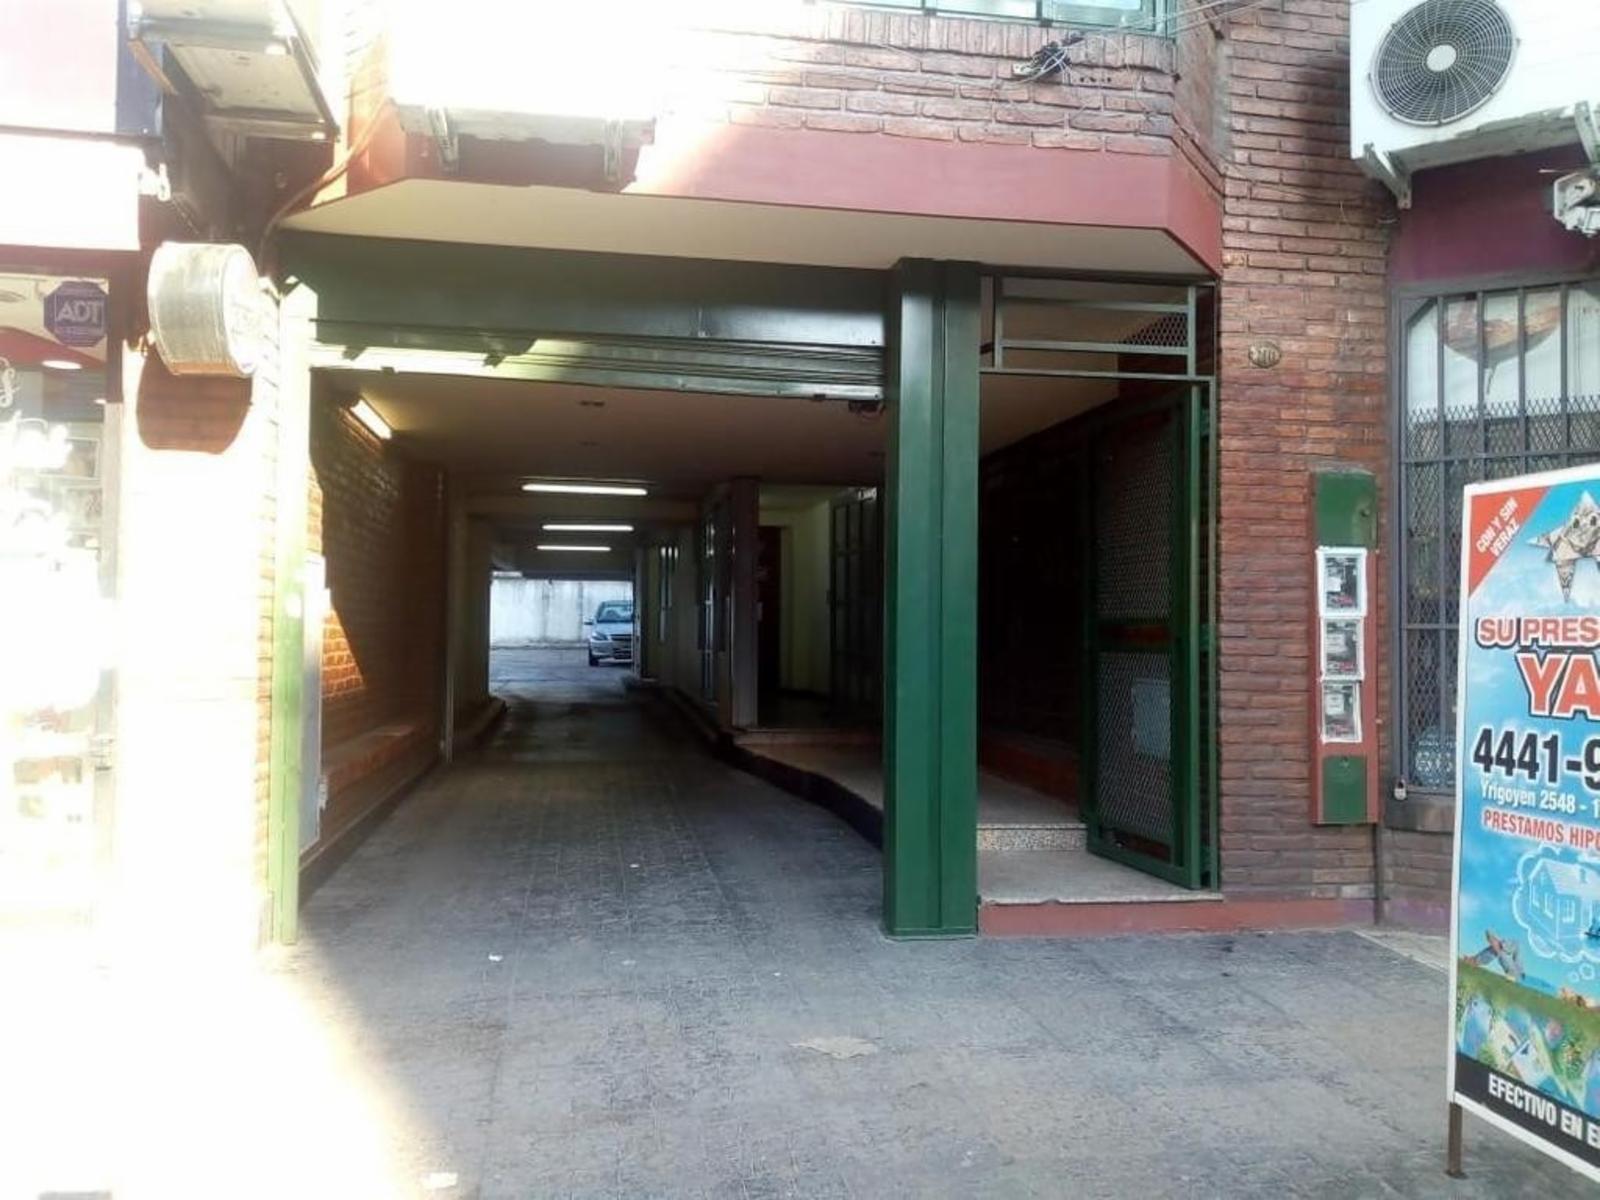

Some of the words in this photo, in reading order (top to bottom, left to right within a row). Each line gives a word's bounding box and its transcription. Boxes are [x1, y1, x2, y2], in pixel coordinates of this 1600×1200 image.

[56, 299, 103, 324] ADT
[1476, 525, 1496, 553] CON
[1491, 516, 1502, 530] Y
[1499, 496, 1518, 521] SIN
[1489, 517, 1520, 557] VERAZ
[1478, 616, 1516, 645] SU
[1518, 654, 1600, 717] YA
[1474, 728, 1600, 790] 4441-9
[1480, 777, 1536, 808] Yrigoyen
[1540, 789, 1576, 814] 2548
[1484, 809, 1564, 843] PRESTAMOS
[1488, 1073, 1557, 1127] EFECTIVO
[1561, 1109, 1583, 1140] EN
